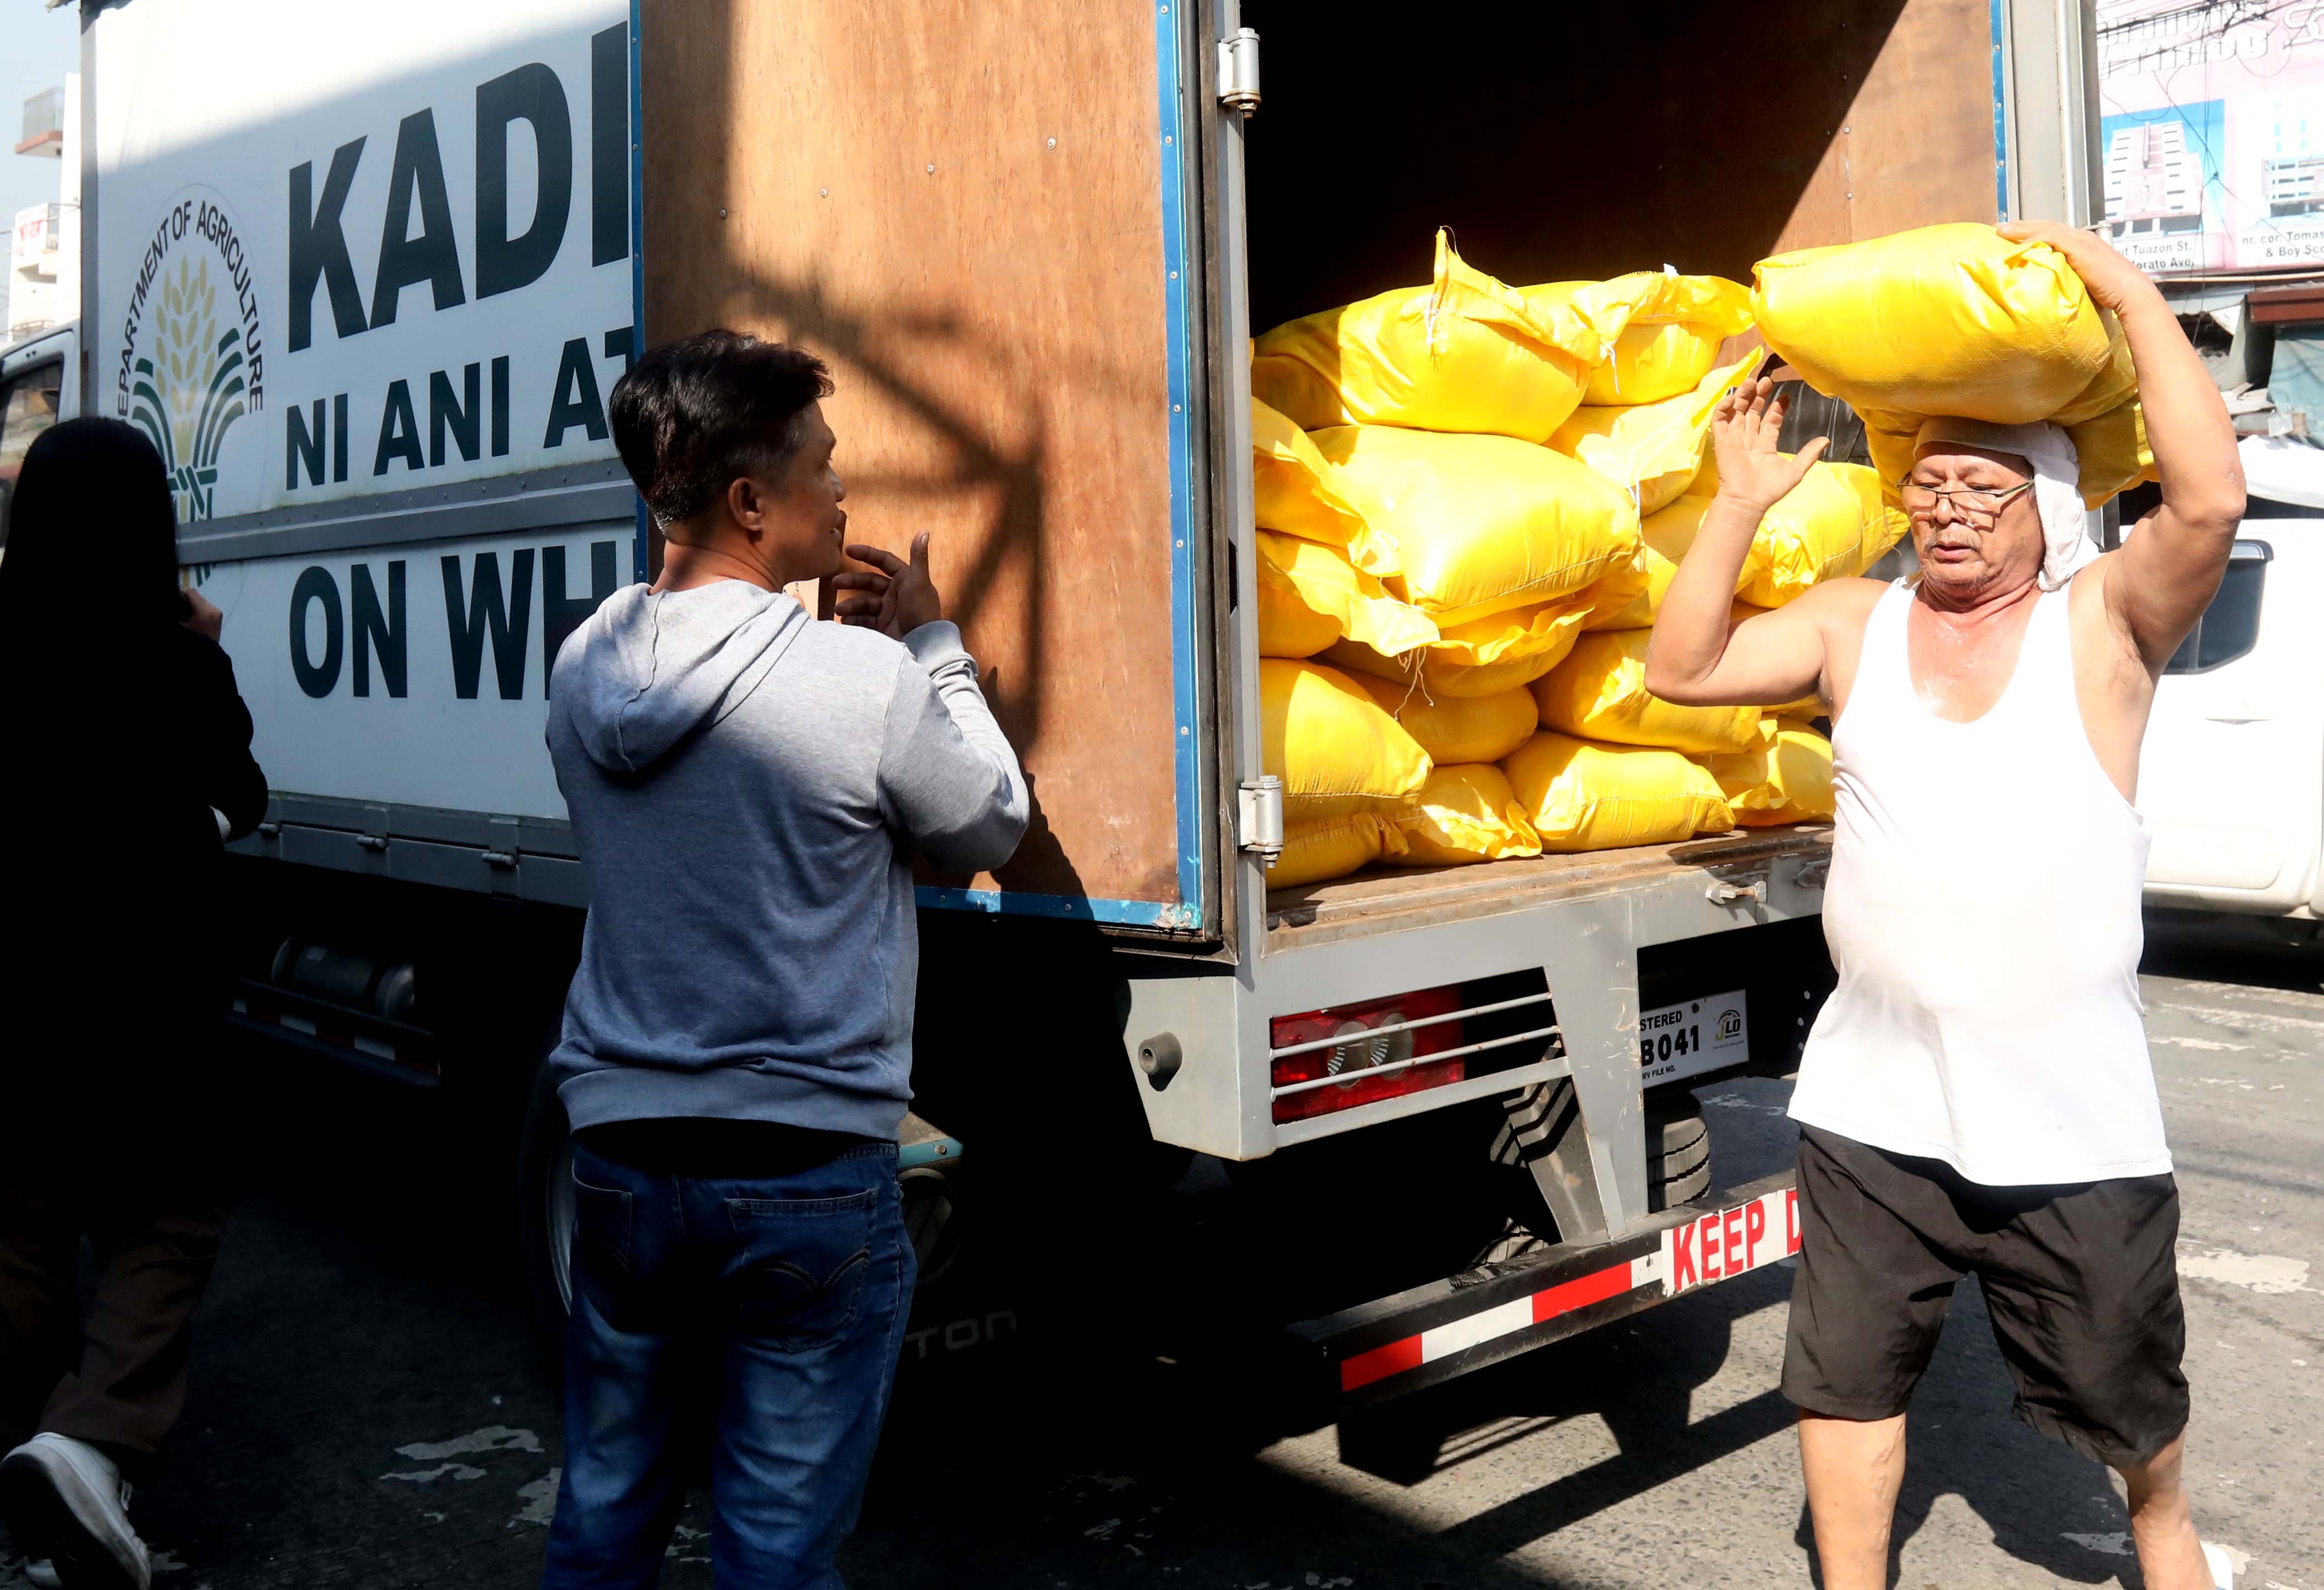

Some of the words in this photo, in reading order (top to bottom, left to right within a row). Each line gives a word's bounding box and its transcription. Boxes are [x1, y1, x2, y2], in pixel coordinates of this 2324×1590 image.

[288, 20, 629, 353] KADI
[2132, 260, 2167, 270] orato
[2133, 245, 2172, 255] Tuazon
[2177, 240, 2192, 251] St.
[2266, 247, 2273, 257] &
[2279, 246, 2300, 258] Boy
[117, 218, 169, 421] EPARTMENT
[172, 201, 192, 241] OF
[196, 201, 263, 414] AGRICULTURE
[287, 393, 348, 490] NI
[374, 355, 510, 477] ANI
[290, 560, 407, 699] ON
[441, 539, 637, 701] WH
[1640, 1024, 1699, 1066] B041
[1652, 1068, 1665, 1077] FILE
[1666, 1065, 1676, 1074] NO.
[1673, 1199, 1765, 1293] KEEP
